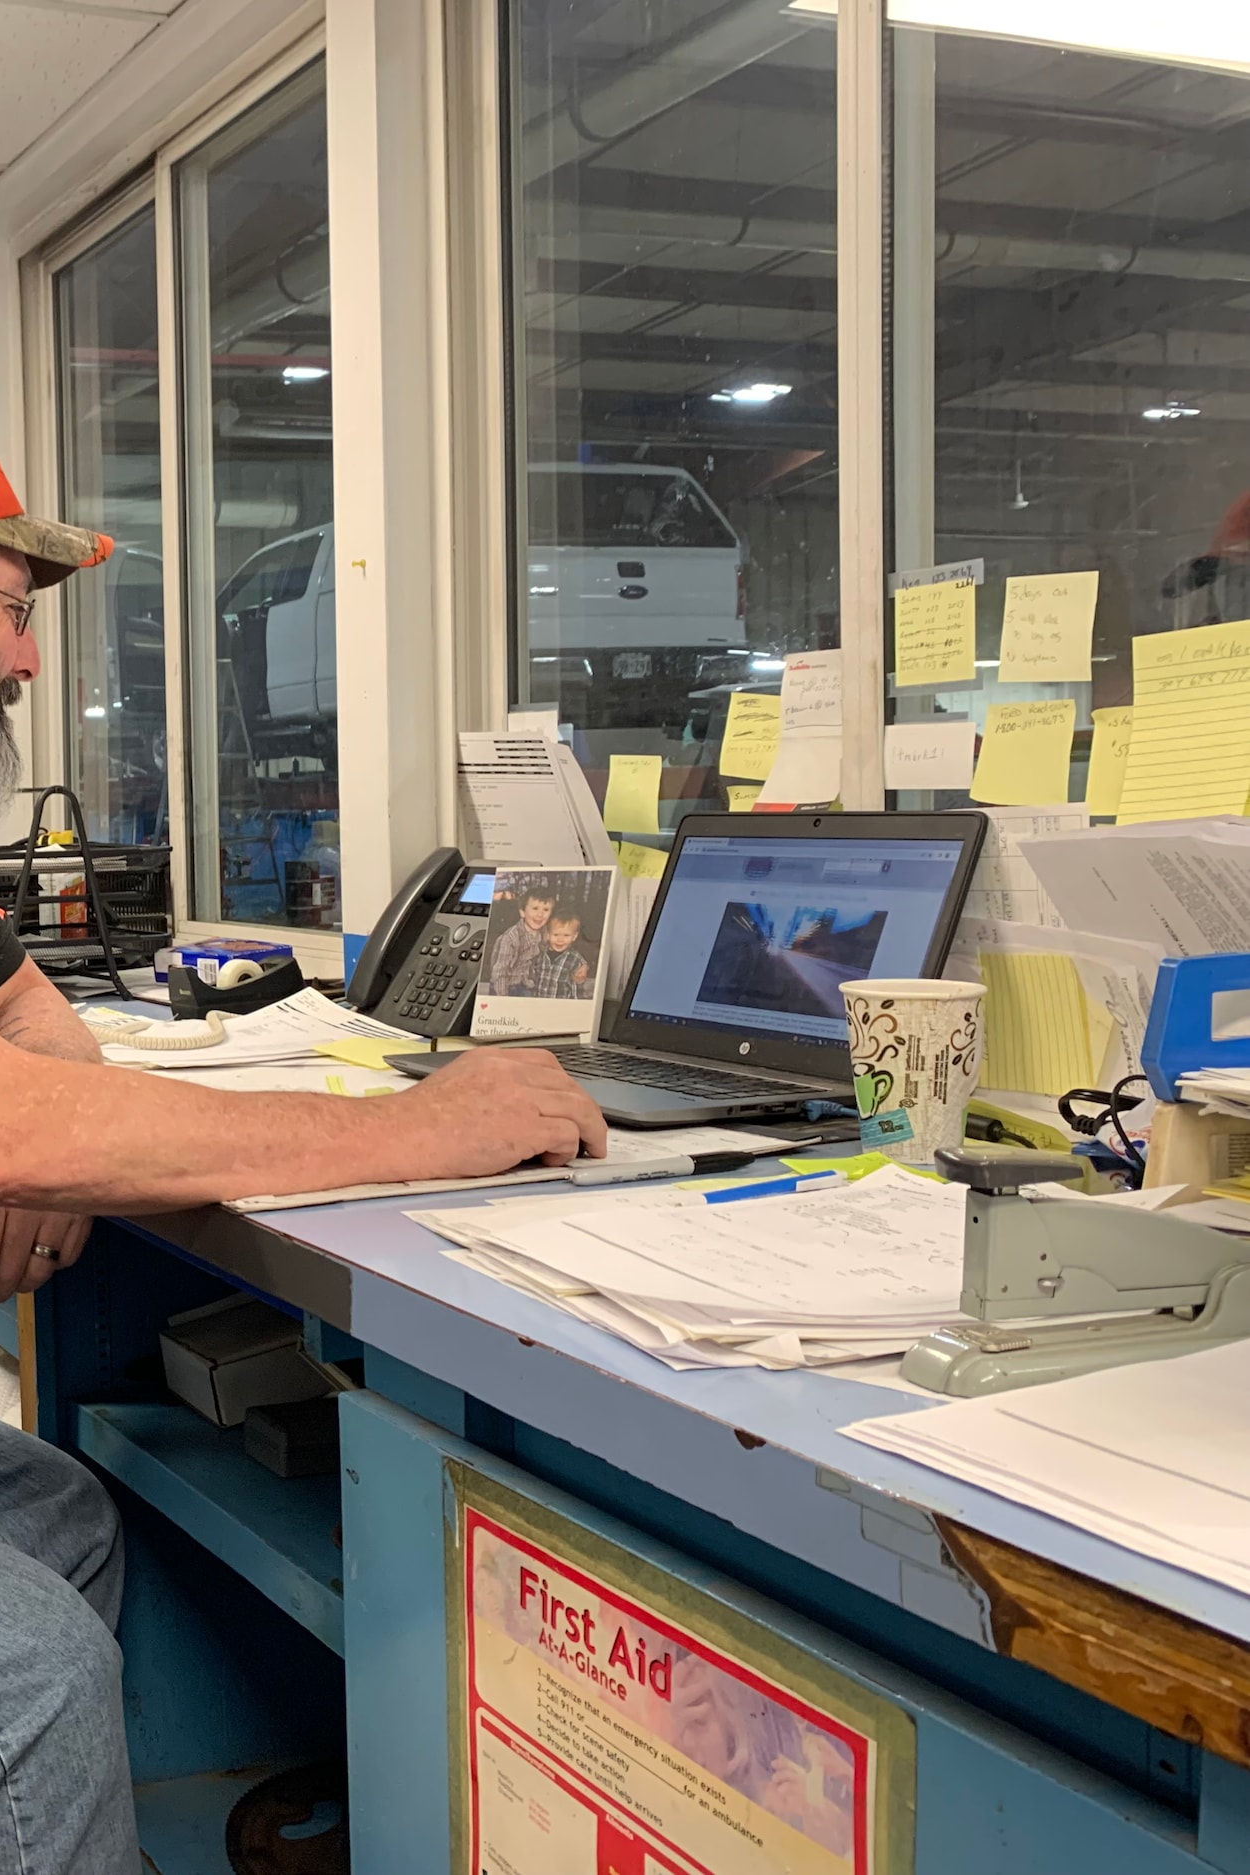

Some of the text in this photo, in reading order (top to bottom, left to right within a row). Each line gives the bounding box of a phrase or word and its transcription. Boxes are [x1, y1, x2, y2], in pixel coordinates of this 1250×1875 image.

[477, 1015, 519, 1026] Grandkids
[878, 1120, 895, 1134] 12
[520, 1566, 672, 1703] First Aid
[539, 1627, 628, 1701] At-A-Glance
[561, 1699, 574, 1716] 911
[576, 1713, 585, 1722] or
[683, 1784, 696, 1800] for
[699, 1798, 710, 1811] an
[712, 1808, 764, 1847] ambulance
[569, 1721, 580, 1734] for
[582, 1732, 604, 1752] scene
[606, 1749, 630, 1772] safety
[572, 1739, 581, 1751] to
[582, 1746, 599, 1763] take
[601, 1761, 625, 1783] action
[584, 1700, 600, 1717] that
[602, 1714, 612, 1726] an
[613, 1722, 658, 1759] emergency
[661, 1753, 698, 1784] situation
[700, 1781, 726, 1805] exists
[576, 1758, 592, 1775] care
[594, 1772, 613, 1790] until
[615, 1784, 633, 1804] help
[635, 1801, 663, 1827] arrives
